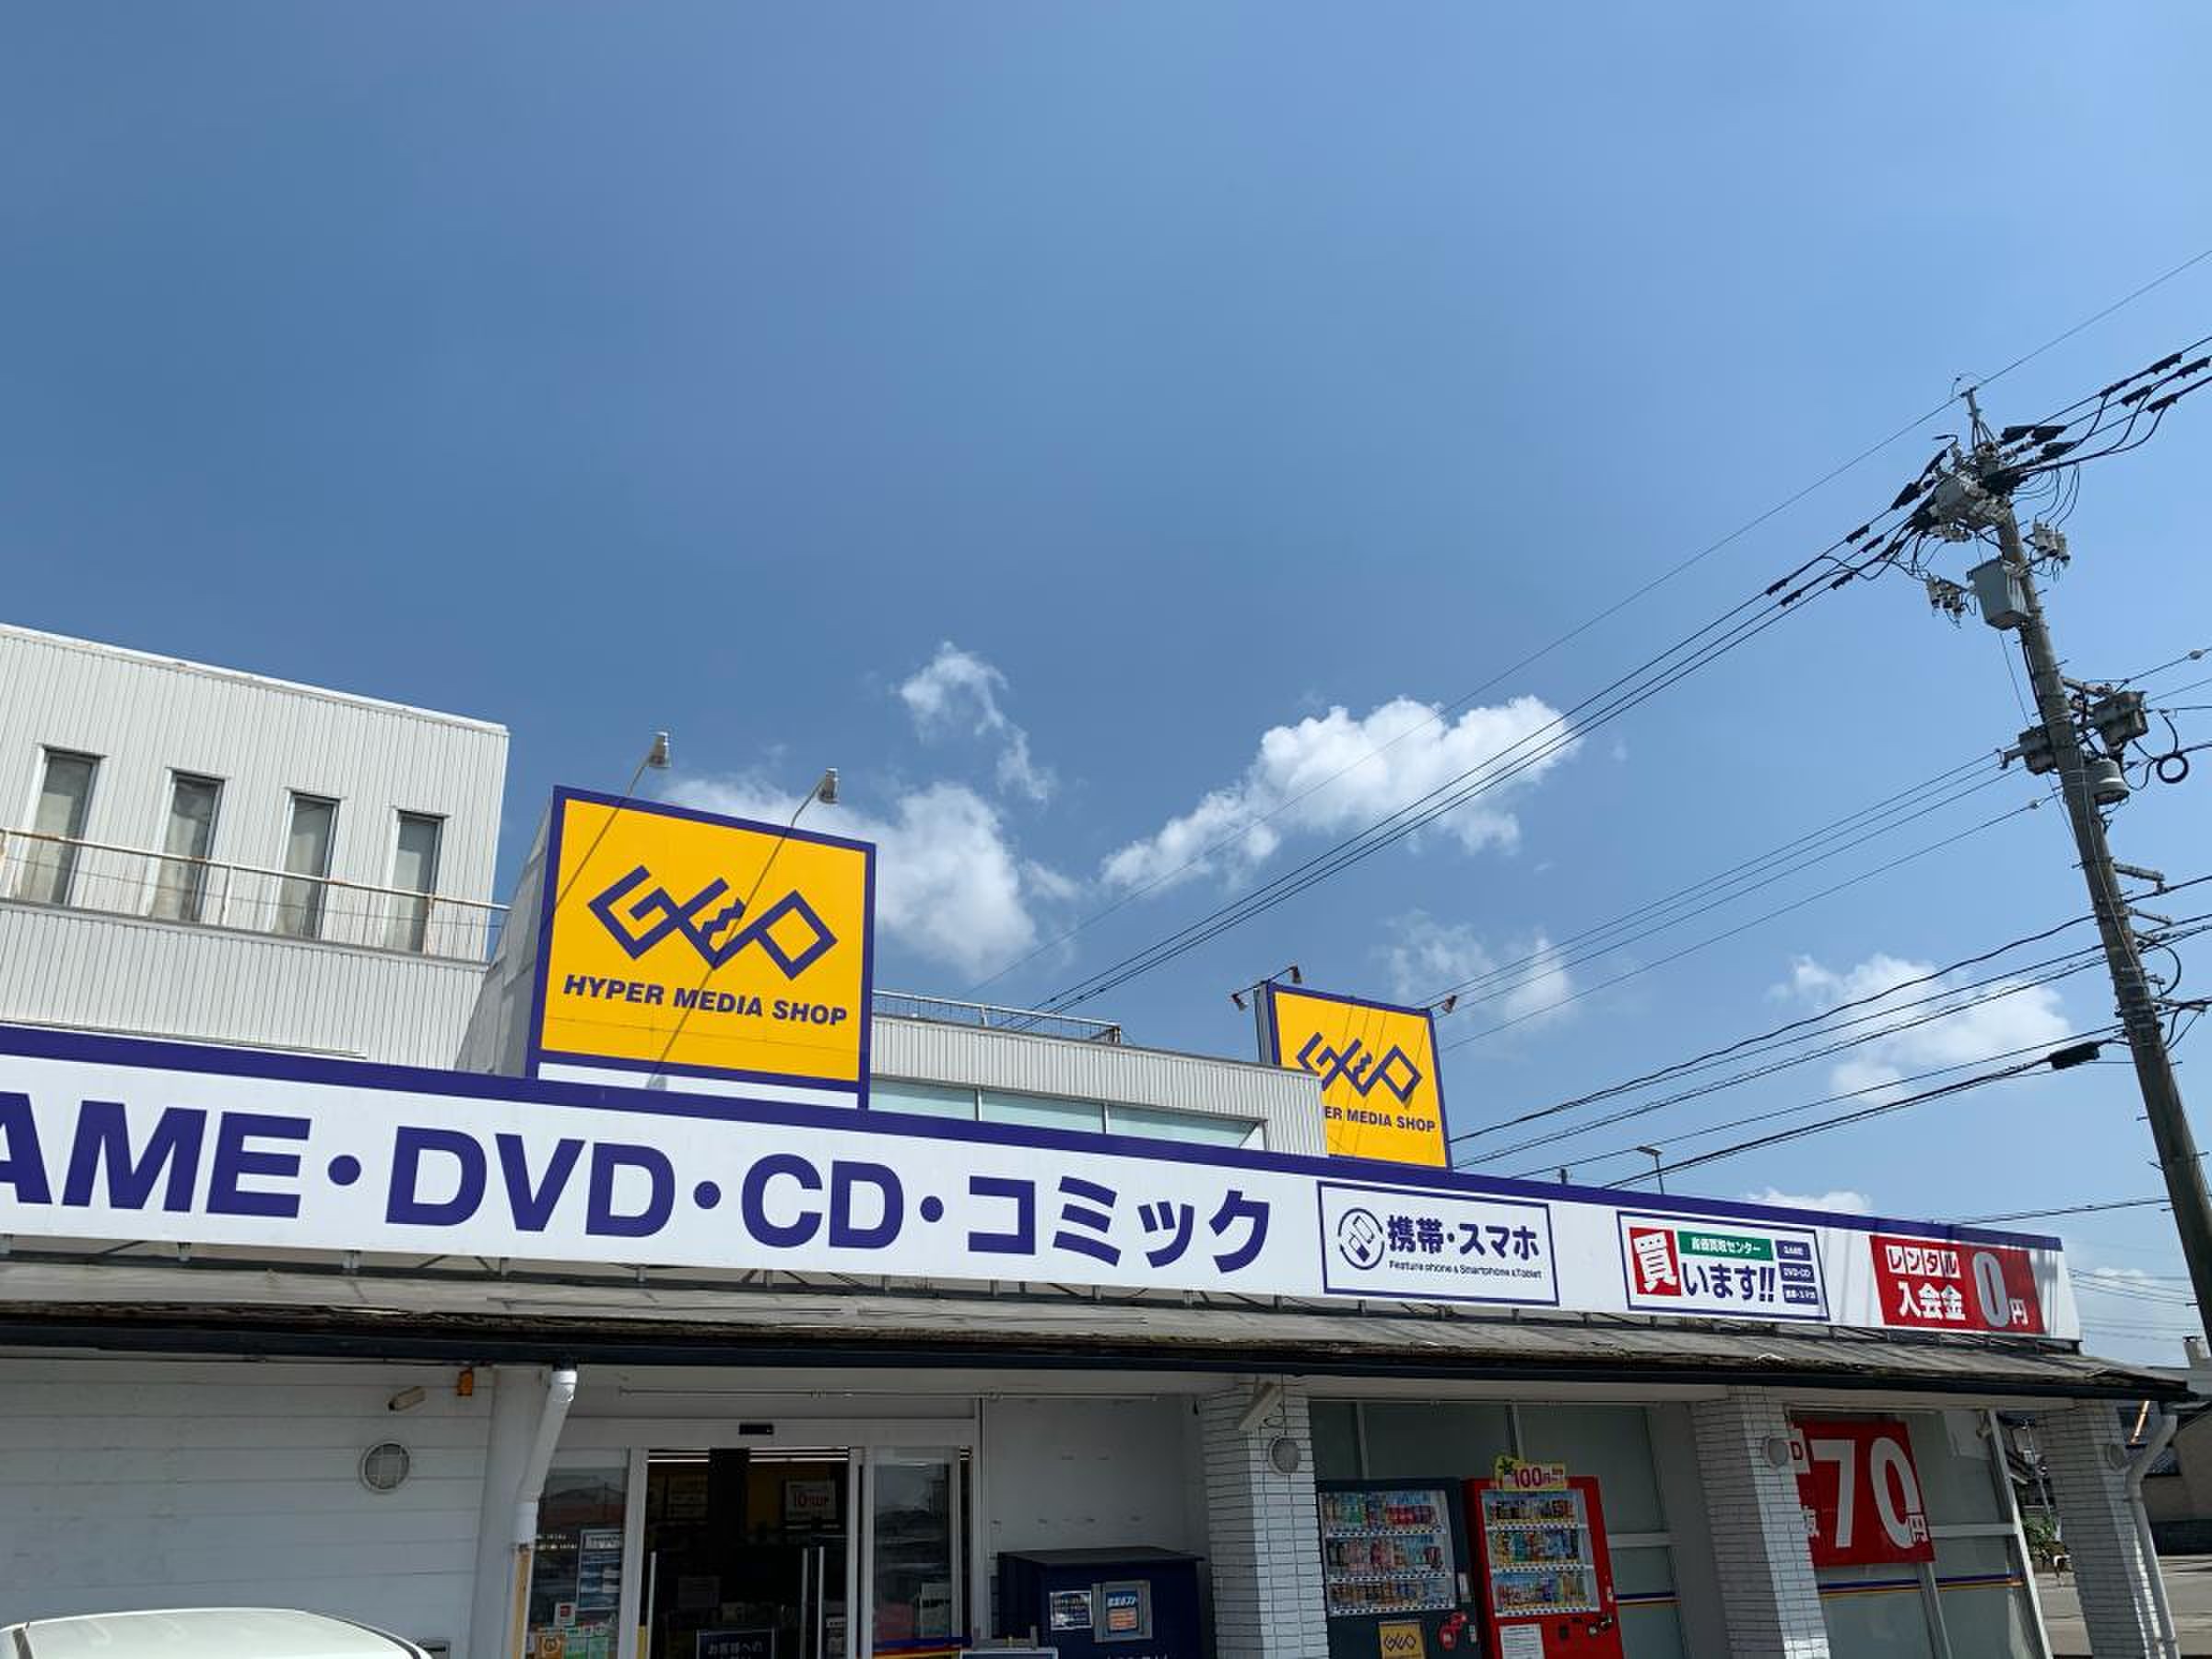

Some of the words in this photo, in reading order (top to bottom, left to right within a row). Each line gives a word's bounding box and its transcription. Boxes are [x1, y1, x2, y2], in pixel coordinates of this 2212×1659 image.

[563, 973, 665, 1005] HYPER
[673, 987, 763, 1017] MEDIA
[772, 1000, 847, 1026] SHOP
[1347, 1108, 1393, 1127] MEDIA
[1396, 1115, 1436, 1133] SHOP
[968, 1175, 1270, 1274] コミック
[1888, 1247, 1959, 1277] レンタル
[1898, 1280, 1966, 1321] 入会金
